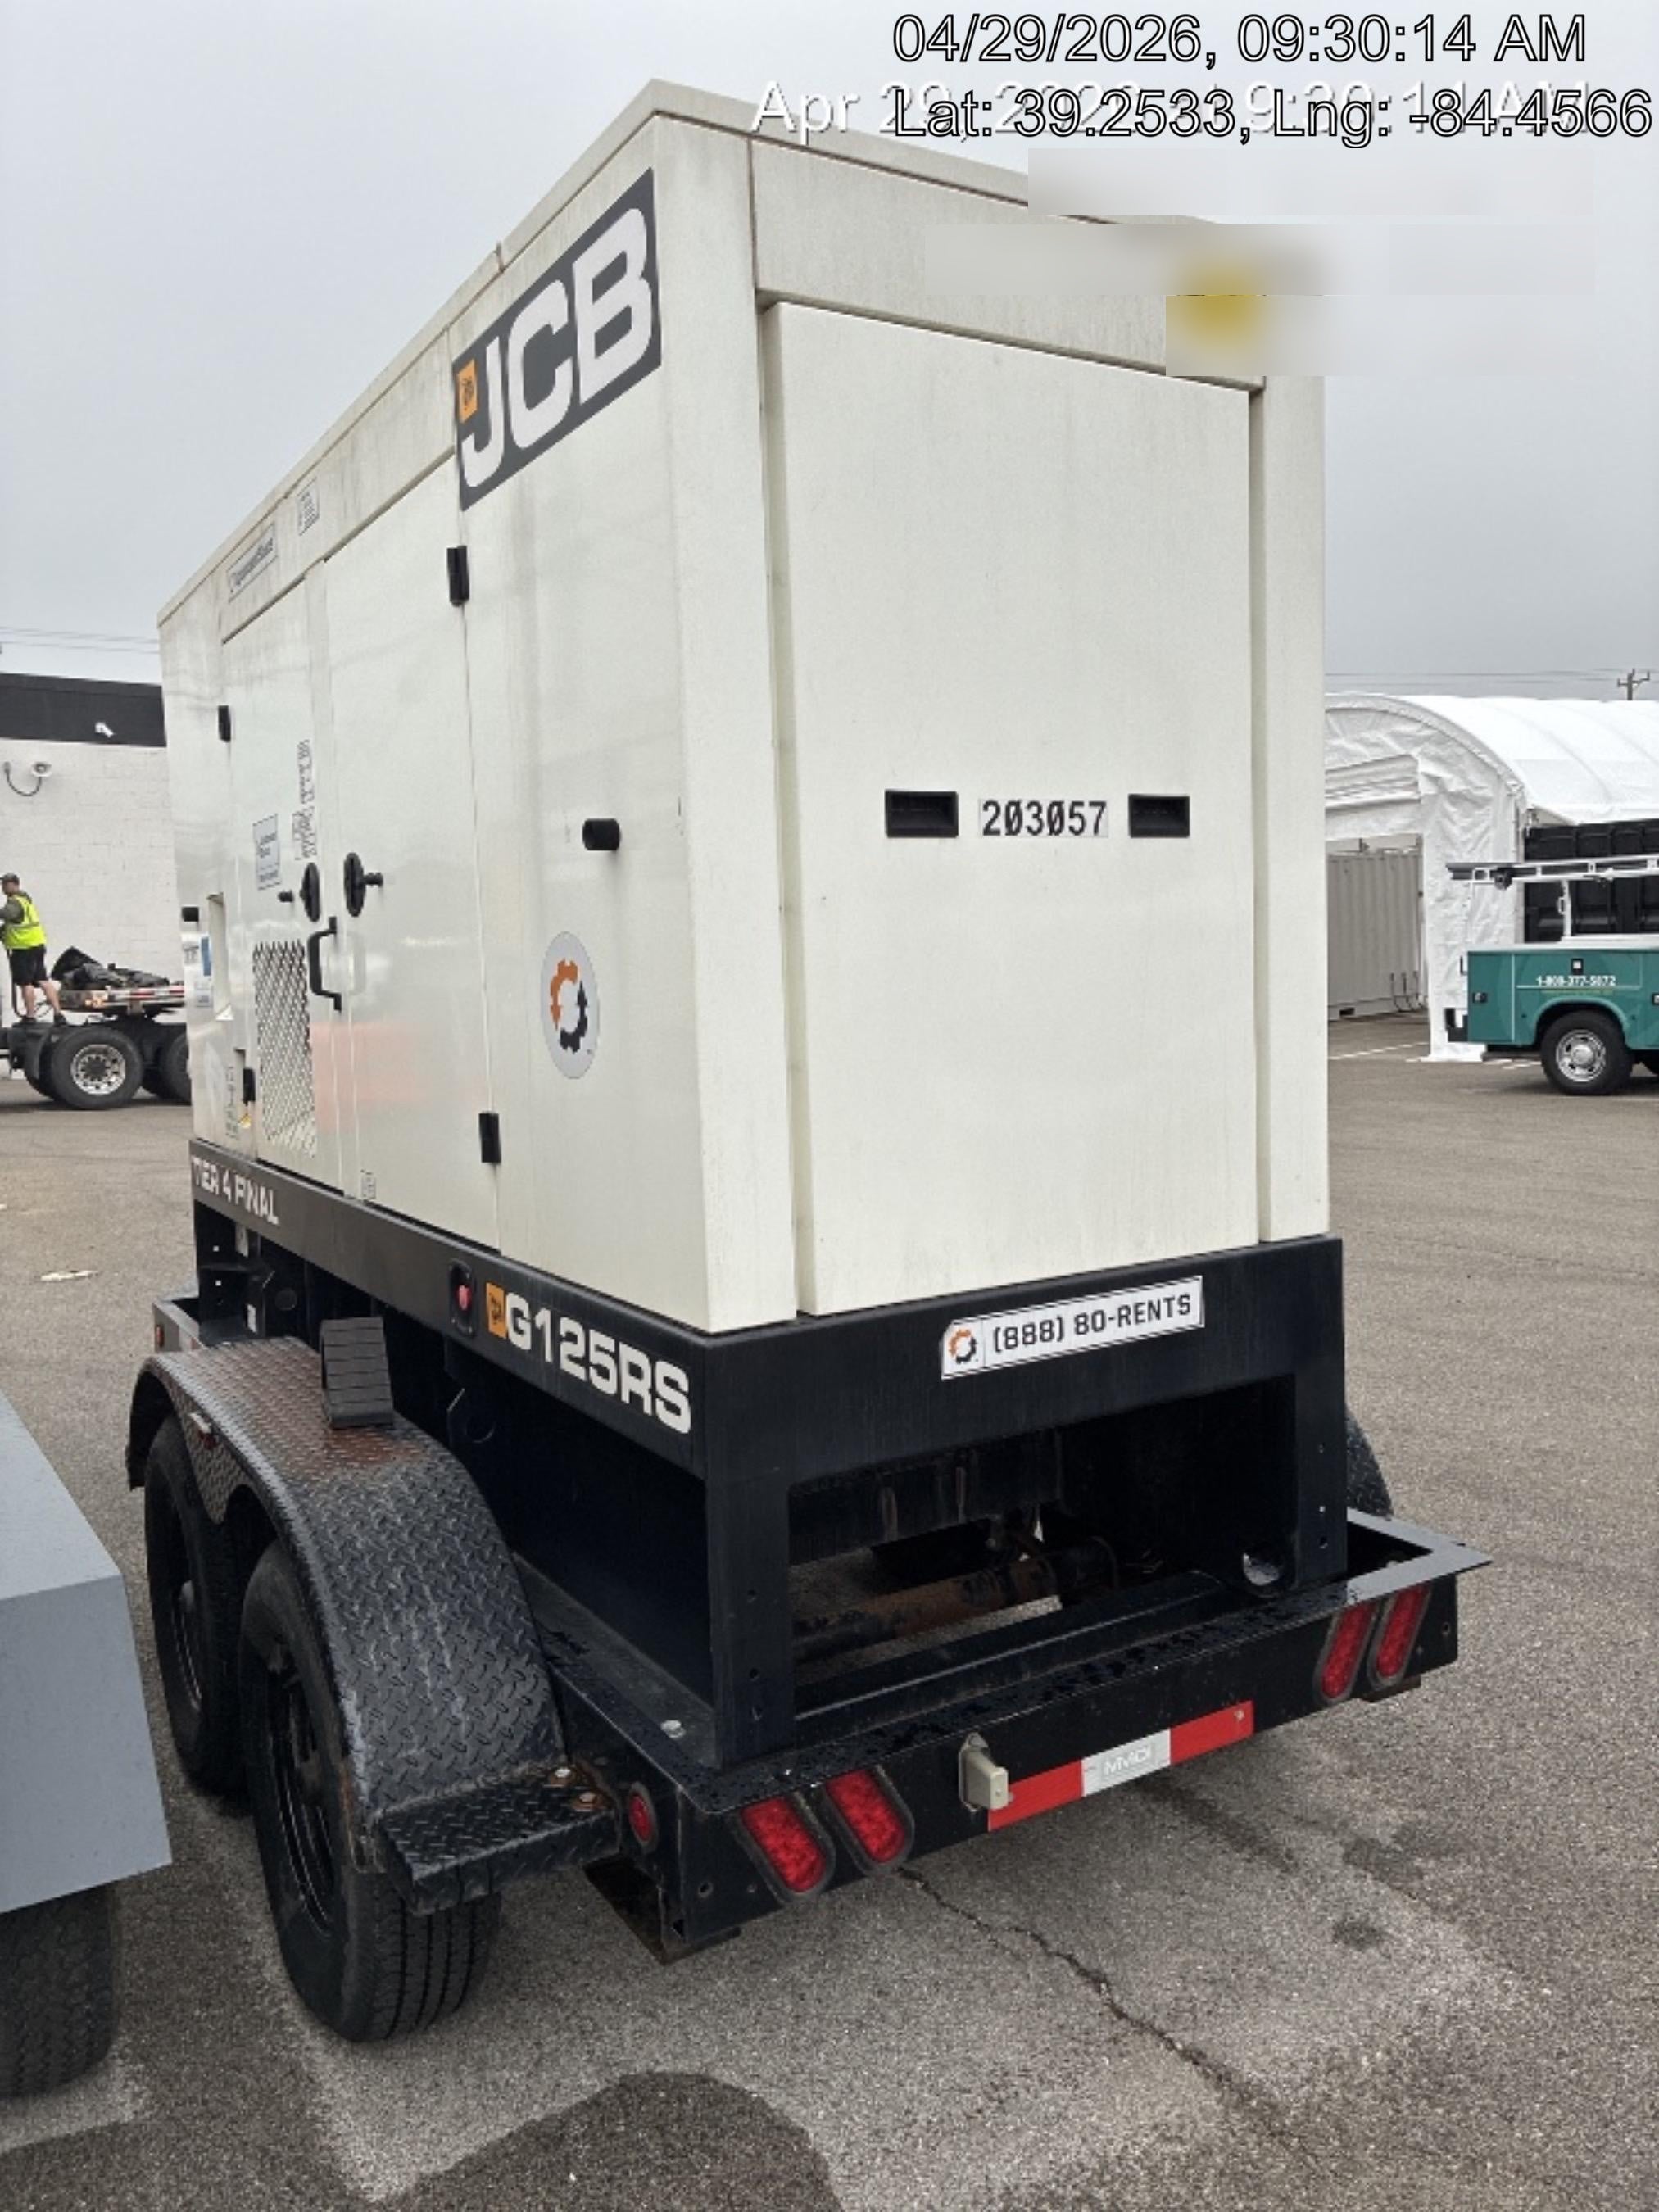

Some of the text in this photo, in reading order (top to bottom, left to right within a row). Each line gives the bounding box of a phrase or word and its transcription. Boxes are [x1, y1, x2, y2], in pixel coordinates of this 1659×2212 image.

[460, 206, 654, 489] JCB
[982, 800, 1107, 836] 203057
[191, 1155, 279, 1226] TIER 4 FINAL
[993, 1293, 1192, 1353] (888) 80-RENTS
[505, 1291, 692, 1435] G125RS
